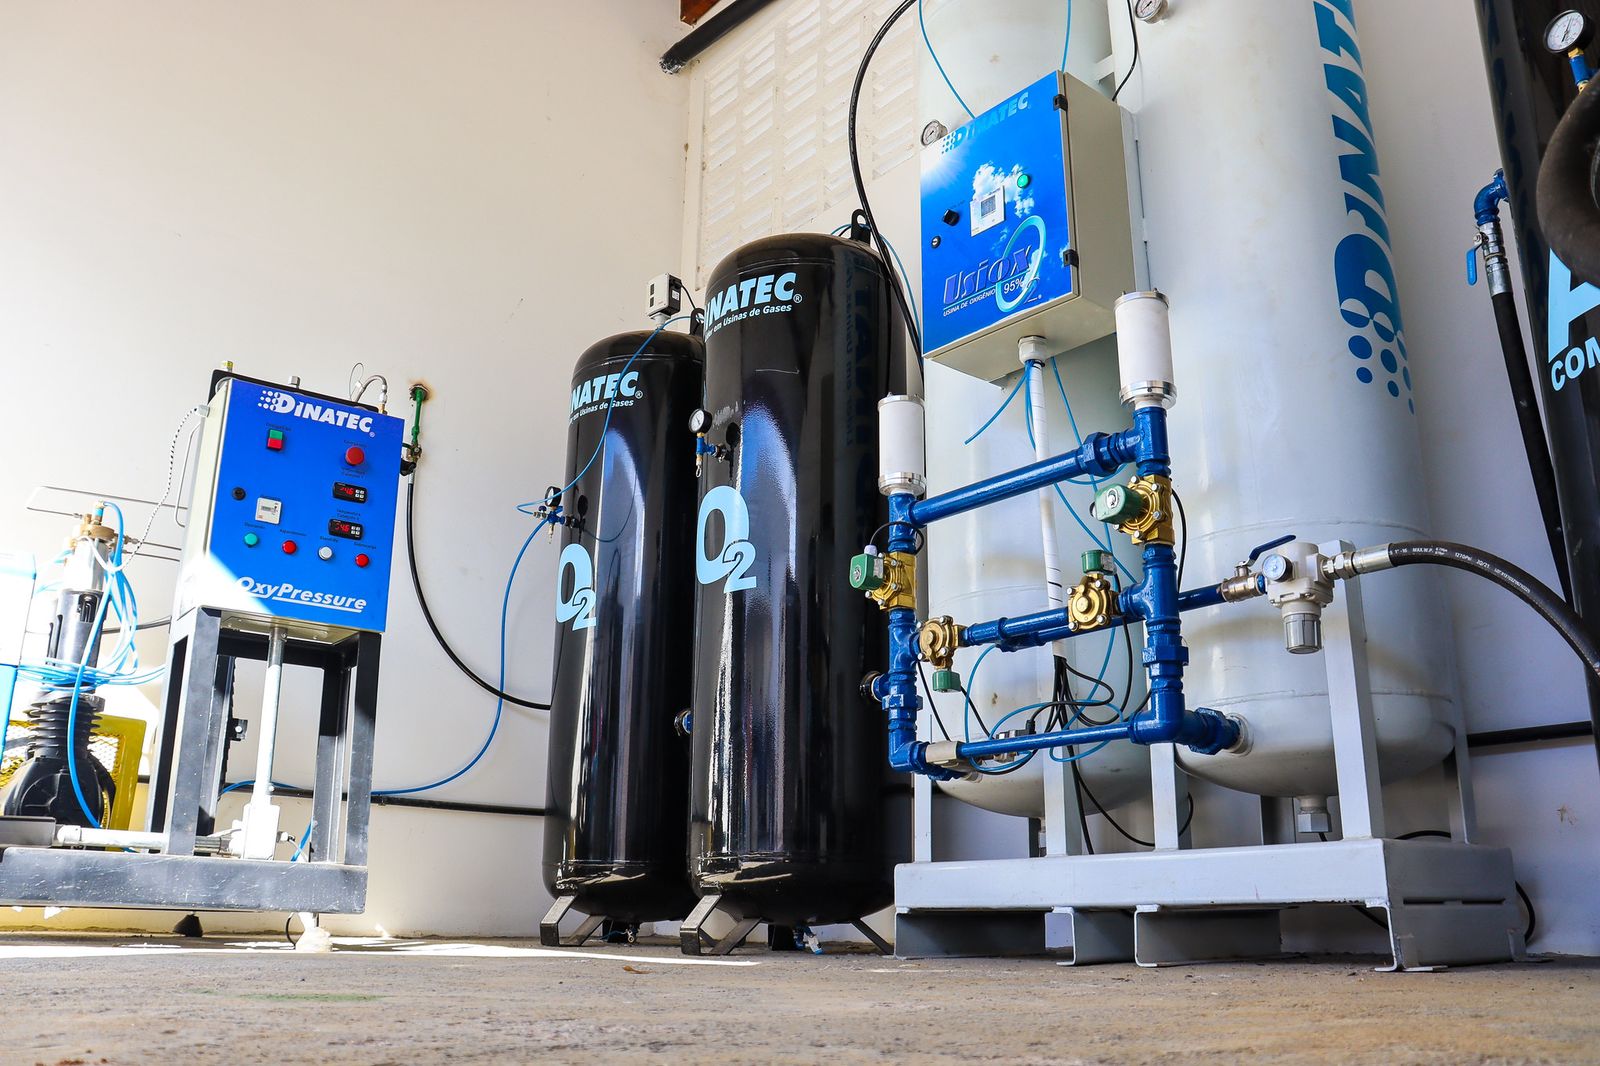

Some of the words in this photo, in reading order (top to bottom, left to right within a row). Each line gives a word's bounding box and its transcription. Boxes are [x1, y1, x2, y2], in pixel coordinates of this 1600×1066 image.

[1313, 0, 1404, 345] DINAT
[704, 272, 797, 332] INATEC
[723, 311, 748, 327] Usinas
[749, 307, 760, 317] de
[762, 304, 793, 315] Gases
[273, 392, 374, 433] DINATEC
[570, 371, 640, 414] NATEC
[599, 401, 609, 410] de
[234, 576, 367, 610] OxyPressure
